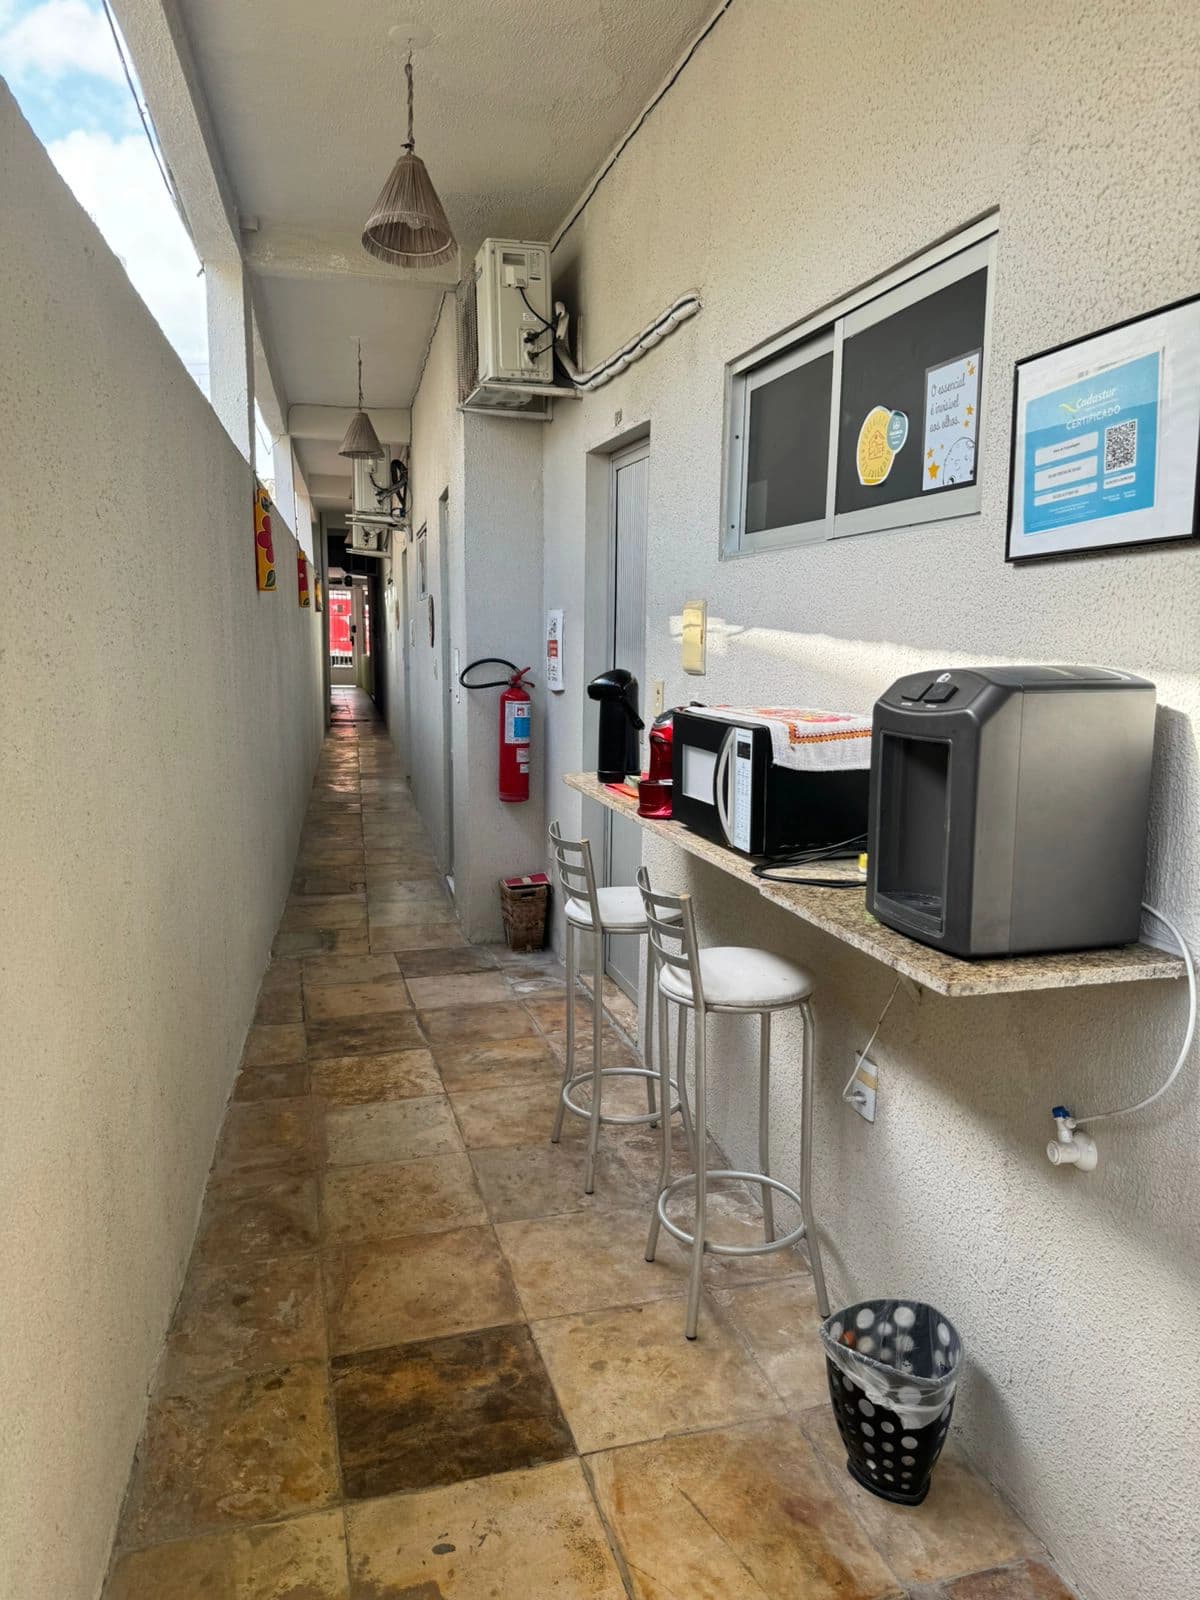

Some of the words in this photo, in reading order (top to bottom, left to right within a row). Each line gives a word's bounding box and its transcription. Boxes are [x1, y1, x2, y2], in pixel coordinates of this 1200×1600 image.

[930, 384, 937, 397] O
[938, 372, 966, 395] essencial
[1076, 387, 1117, 409] Cadastur
[929, 420, 941, 432] aos
[1066, 404, 1121, 430] CERTIFICADO
